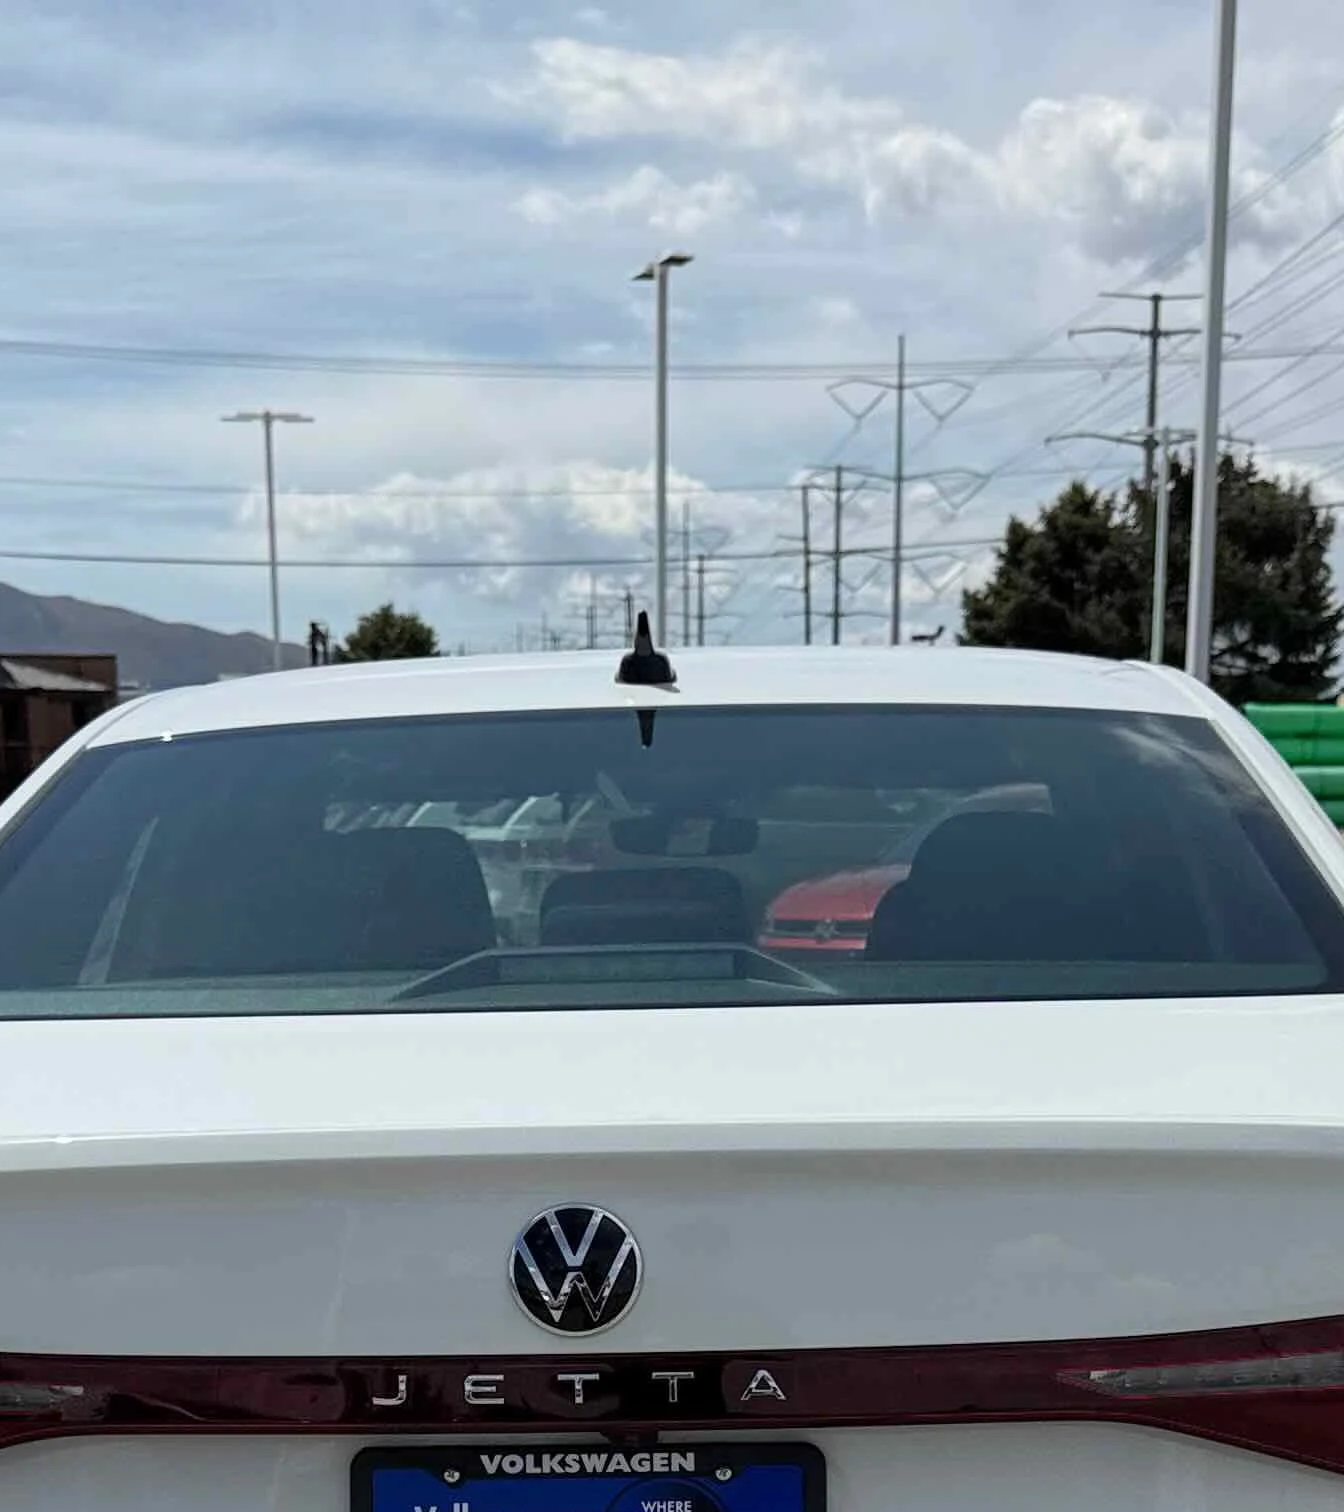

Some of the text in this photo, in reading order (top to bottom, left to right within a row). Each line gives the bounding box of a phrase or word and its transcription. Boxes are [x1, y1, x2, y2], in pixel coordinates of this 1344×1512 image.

[508, 1203, 642, 1337] VW
[372, 1369, 788, 1405] JETTA
[479, 1452, 696, 1475] VOLKSWAGEN
